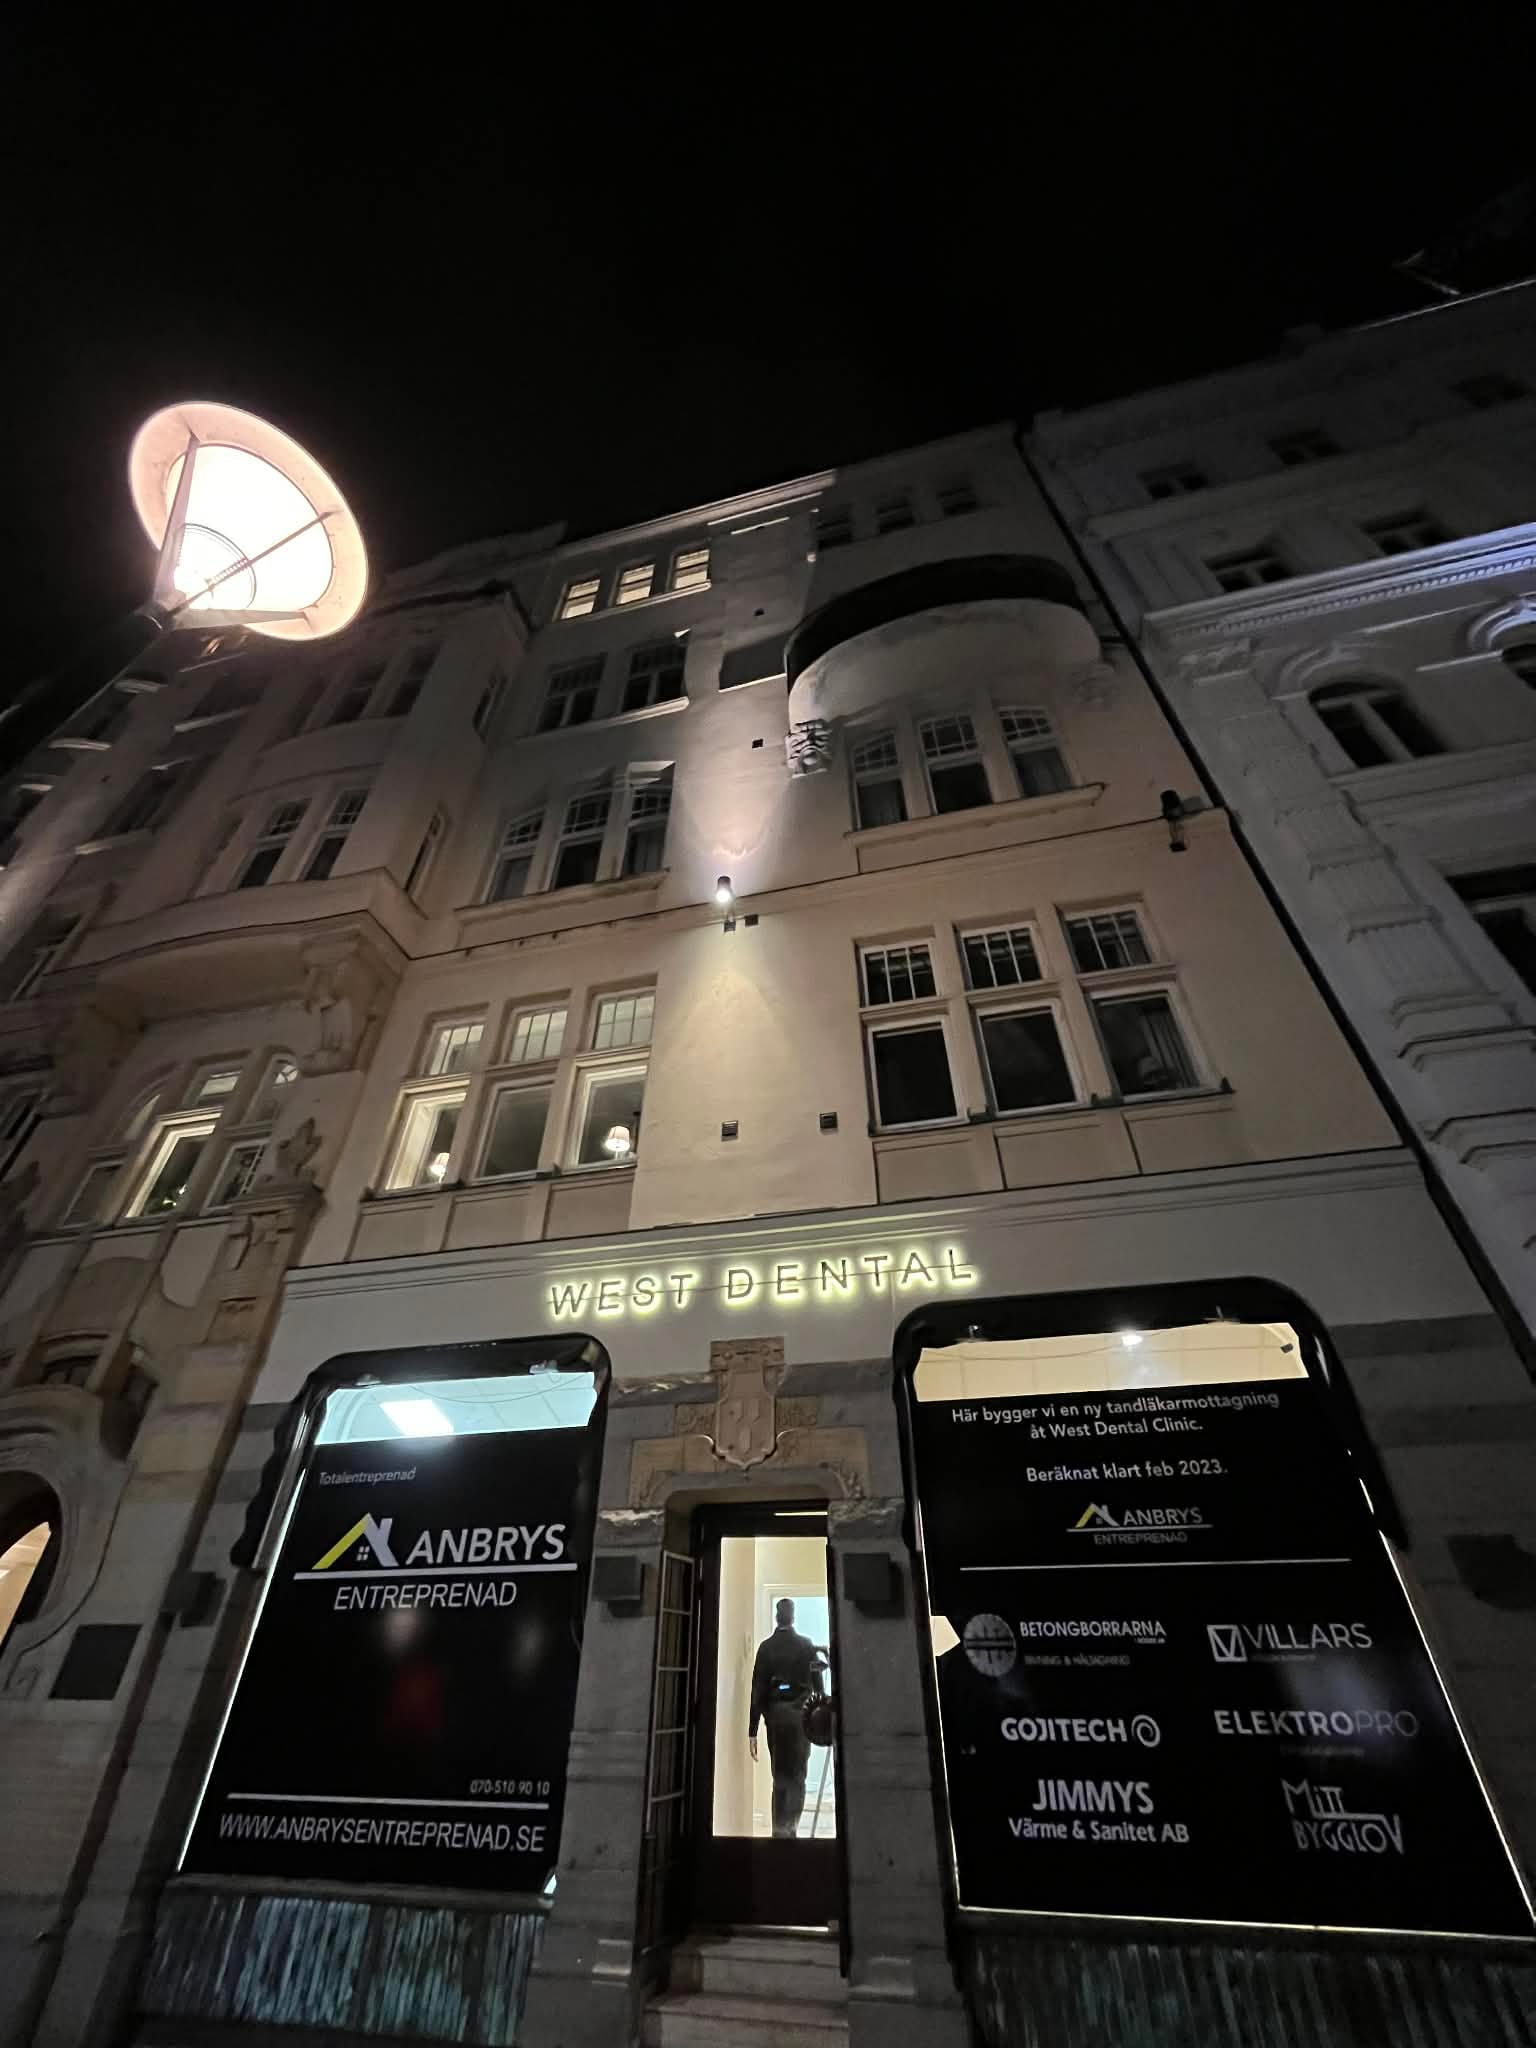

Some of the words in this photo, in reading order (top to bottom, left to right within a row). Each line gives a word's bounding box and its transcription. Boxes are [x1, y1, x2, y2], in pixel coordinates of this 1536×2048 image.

[550, 1273, 694, 1316] WEST
[726, 1248, 974, 1300] DENTAL
[951, 1407, 979, 1423] Här
[983, 1406, 1037, 1425] bygger
[1041, 1404, 1056, 1418] vi
[1060, 1405, 1080, 1417] en
[1083, 1403, 1102, 1419] ny
[1105, 1391, 1281, 1414] tandläkarmottagning
[1029, 1424, 1047, 1440] åt
[1049, 1422, 1091, 1438] West
[1094, 1418, 1149, 1435] Dental
[1152, 1416, 1203, 1433] Clinic.
[319, 1467, 417, 1486] Totalentreprenad
[1026, 1465, 1100, 1482] Beräknat
[1102, 1462, 1143, 1479] klart
[1145, 1460, 1175, 1477] feb
[1177, 1458, 1229, 1476] 2023.
[1122, 1507, 1203, 1526] ANBRYS
[405, 1523, 566, 1566] ANBRYS
[1093, 1532, 1188, 1545] ENTREPRENAD
[333, 1581, 518, 1611] ENTREPRENAD
[1019, 1620, 1167, 1638] BETONGBORRARNA
[1241, 1623, 1373, 1649] VILLARS
[1000, 1716, 1128, 1743] GOJITECH
[1213, 1709, 1420, 1737] ELEKTROPRO
[1032, 1778, 1155, 1815] JIMMYS
[218, 1813, 548, 1852] WWW.ANBRYSENTREPRENAD.SE
[1008, 1816, 1068, 1840] Värme
[1071, 1819, 1087, 1840] &
[1090, 1820, 1157, 1843] Sanitet
[1160, 1823, 1190, 1844] AB
[1292, 1813, 1405, 1855] BYGGLOV
